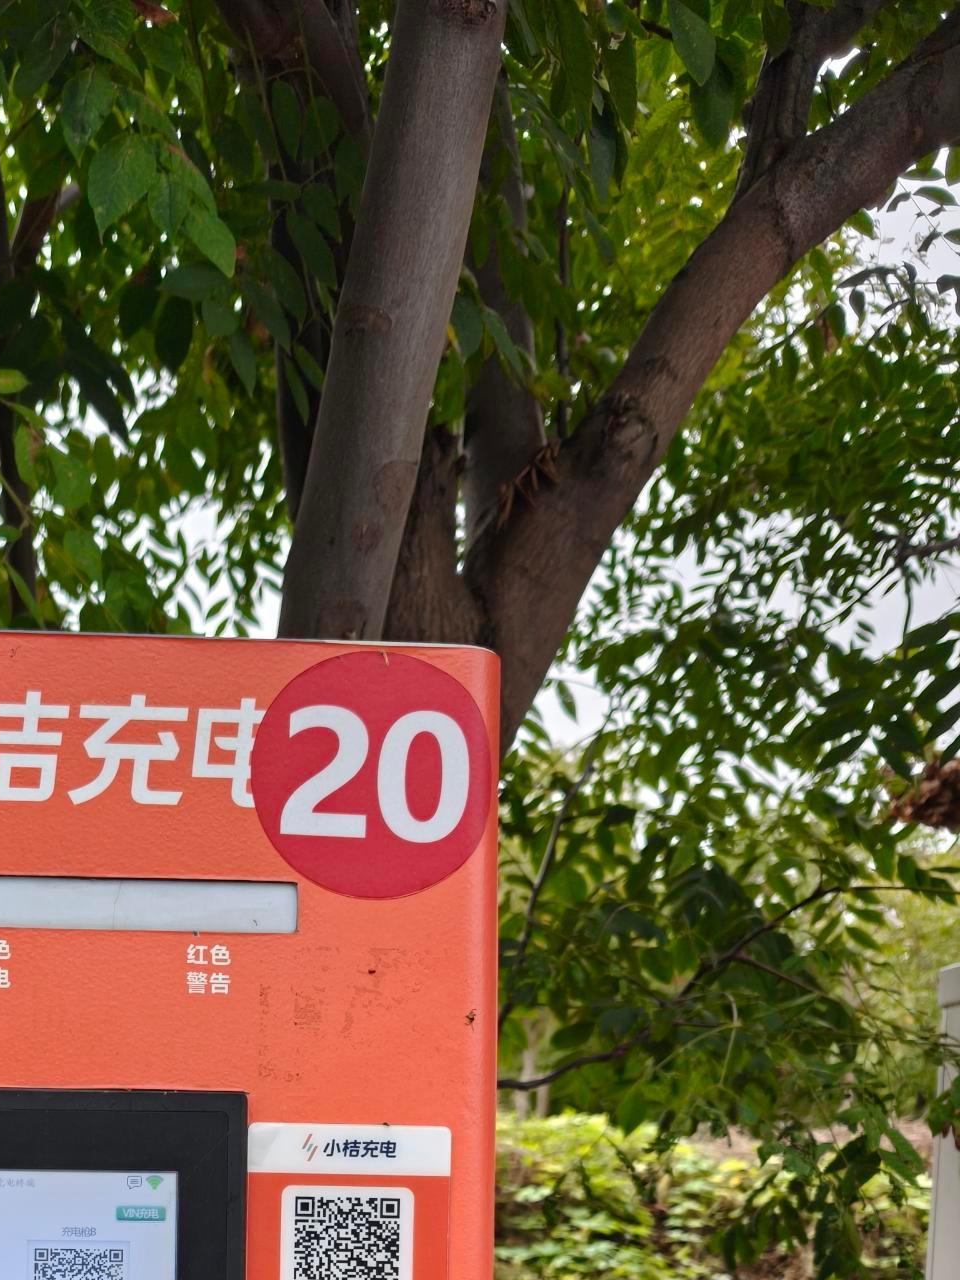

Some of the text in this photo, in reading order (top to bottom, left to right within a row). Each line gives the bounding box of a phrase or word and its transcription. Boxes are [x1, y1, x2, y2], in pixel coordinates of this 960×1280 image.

[279, 705, 470, 844] 20
[186, 944, 231, 967] 红色
[186, 971, 231, 995] 警告
[323, 1139, 397, 1159] 小桔充电
